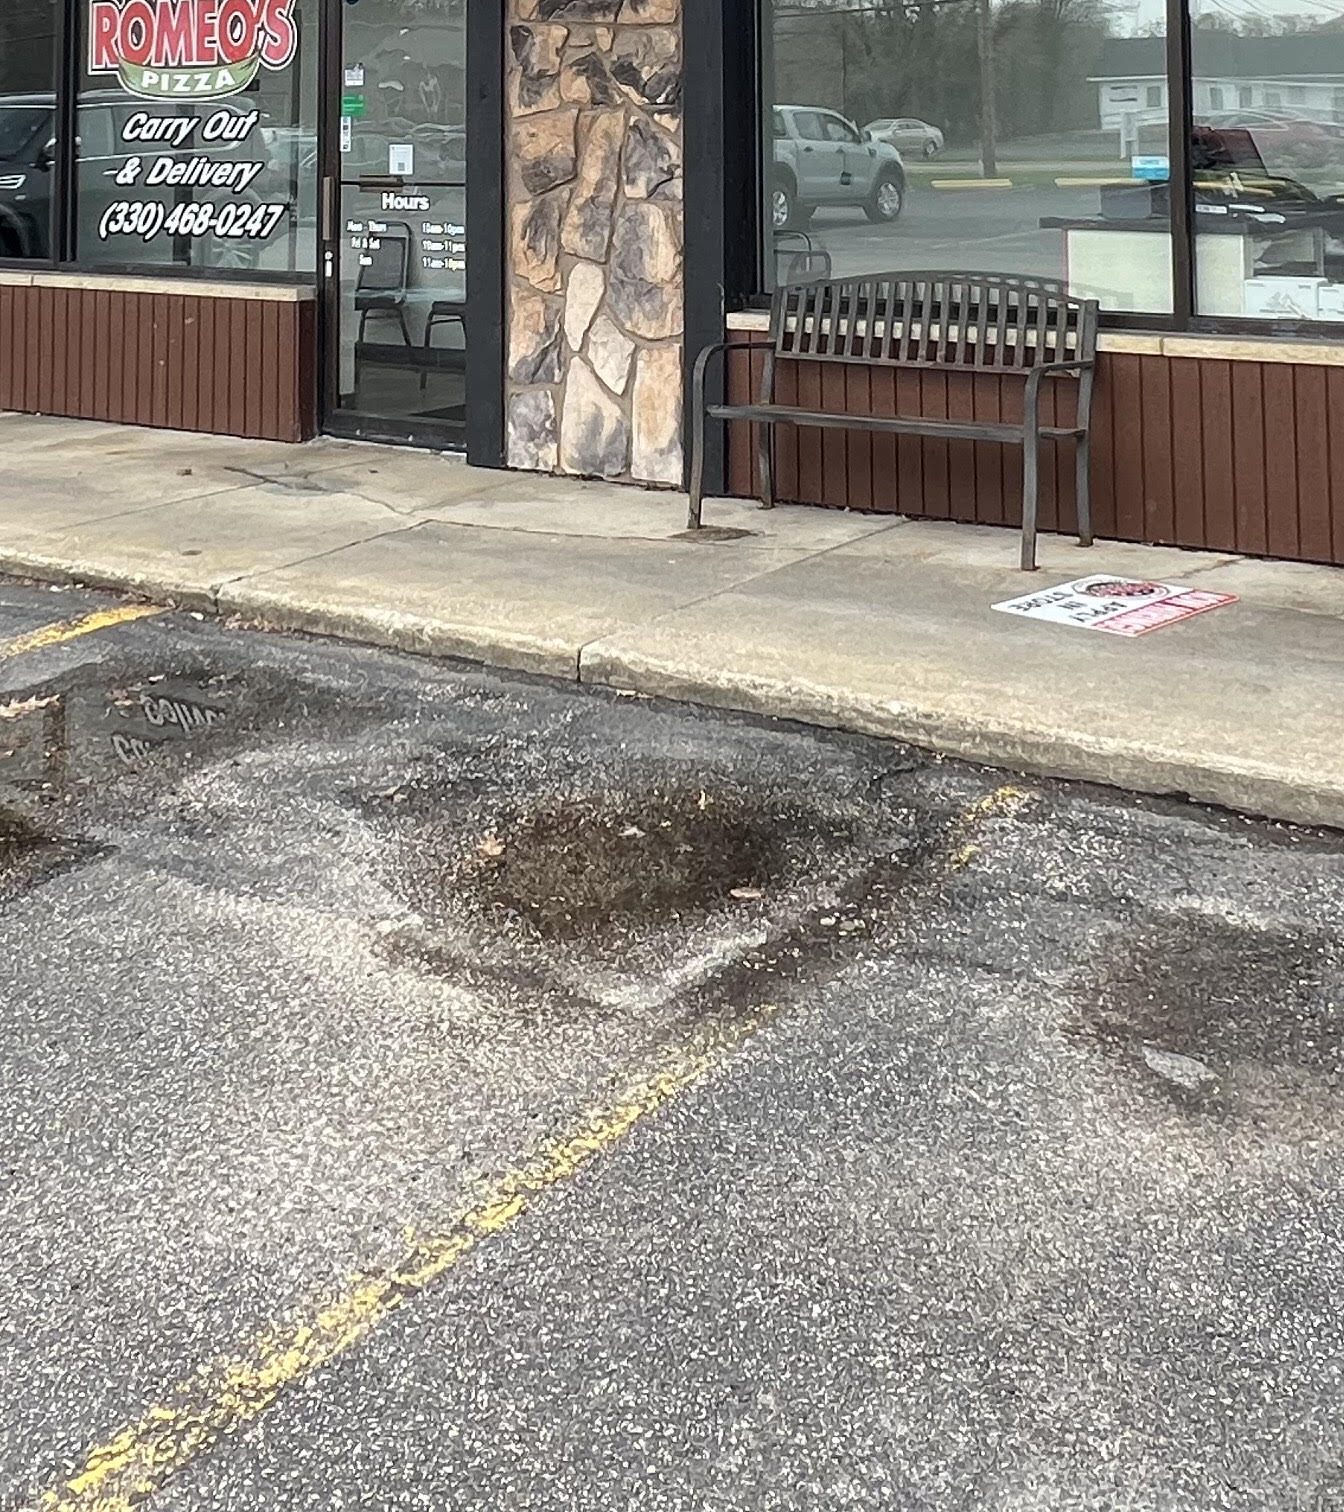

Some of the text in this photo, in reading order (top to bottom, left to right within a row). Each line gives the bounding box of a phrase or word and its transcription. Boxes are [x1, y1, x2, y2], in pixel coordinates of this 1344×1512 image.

[141, 69, 236, 93] PIZZA
[123, 111, 258, 146] Carry Out
[116, 157, 263, 193] & Delivery
[381, 192, 430, 210] Hours
